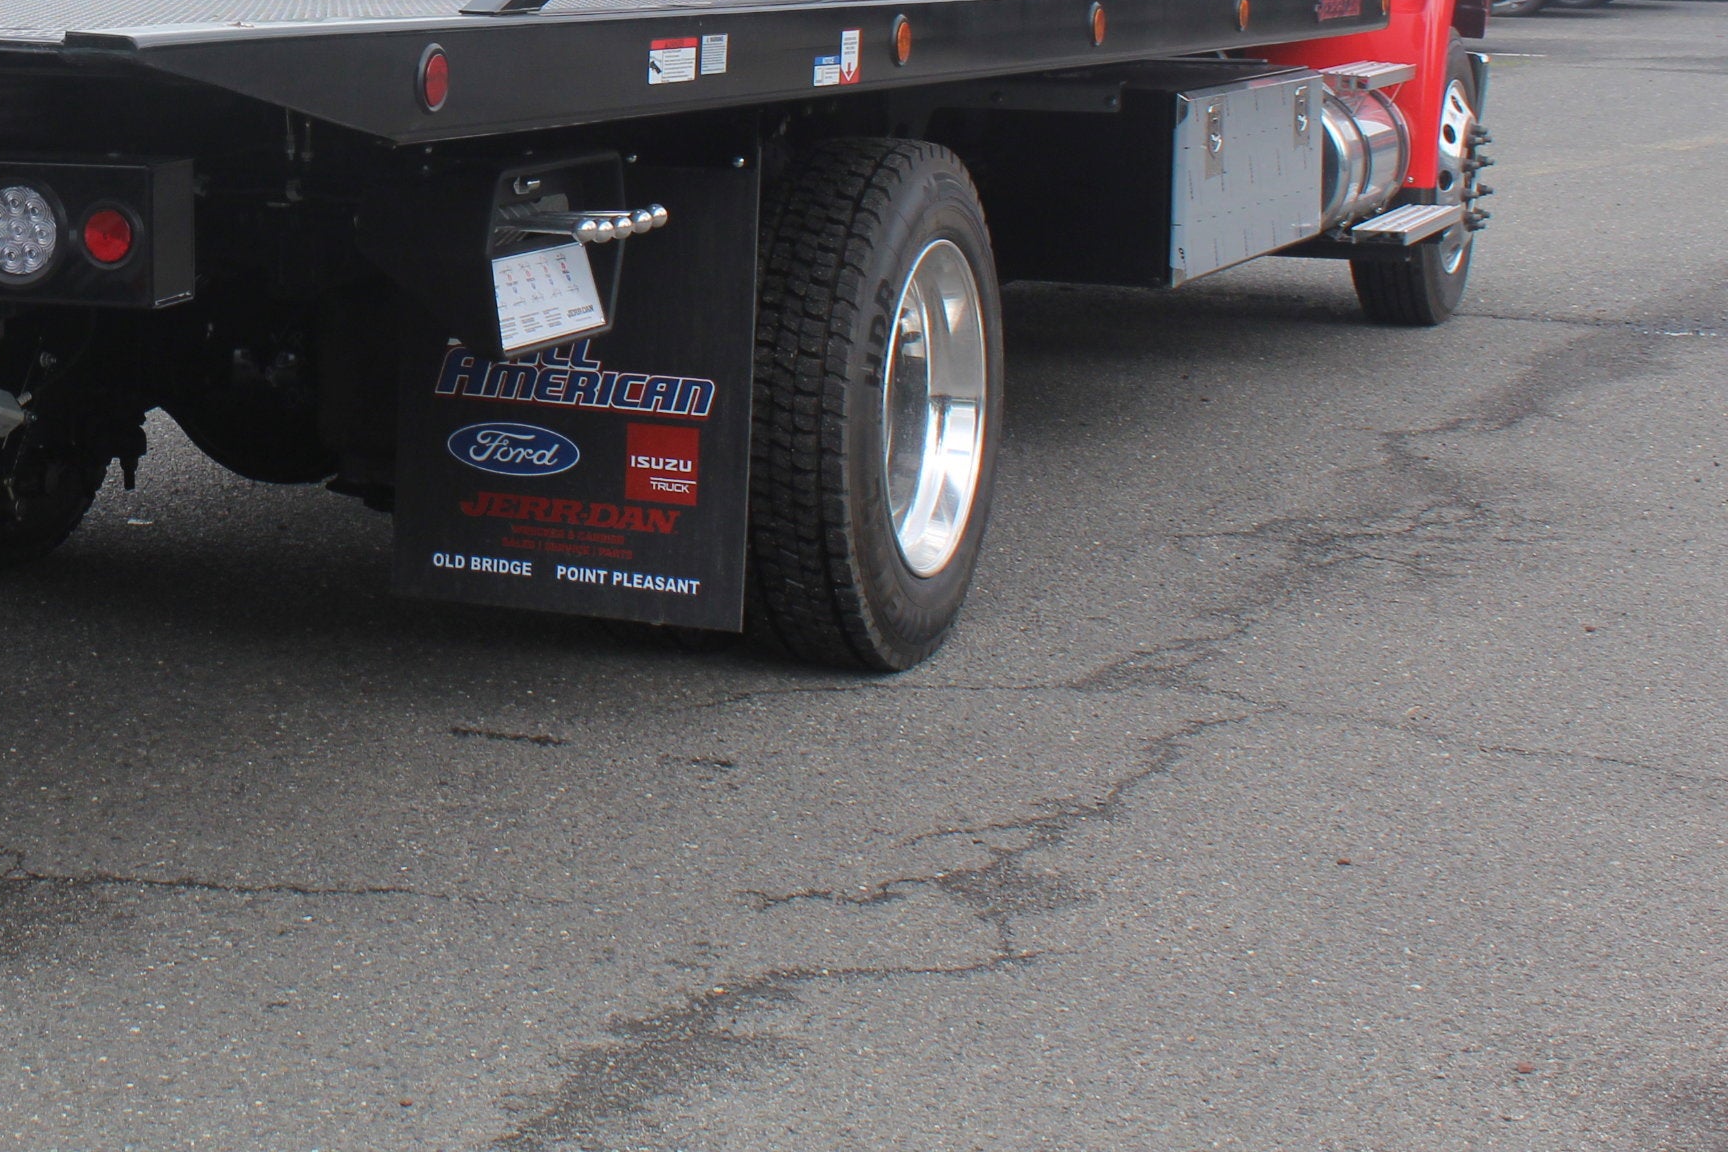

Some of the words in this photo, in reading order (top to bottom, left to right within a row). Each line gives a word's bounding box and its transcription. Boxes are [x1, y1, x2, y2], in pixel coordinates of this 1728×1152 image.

[435, 347, 716, 416] AMERICAN
[469, 430, 560, 466] Ford
[631, 455, 692, 472] ISUZU
[650, 480, 690, 494] TRUCK
[459, 491, 682, 534] JERR-DAN
[433, 552, 465, 569] OLD
[471, 556, 532, 576] BRIDGE
[557, 565, 607, 586] POINT
[613, 571, 700, 595] PLEASANT
